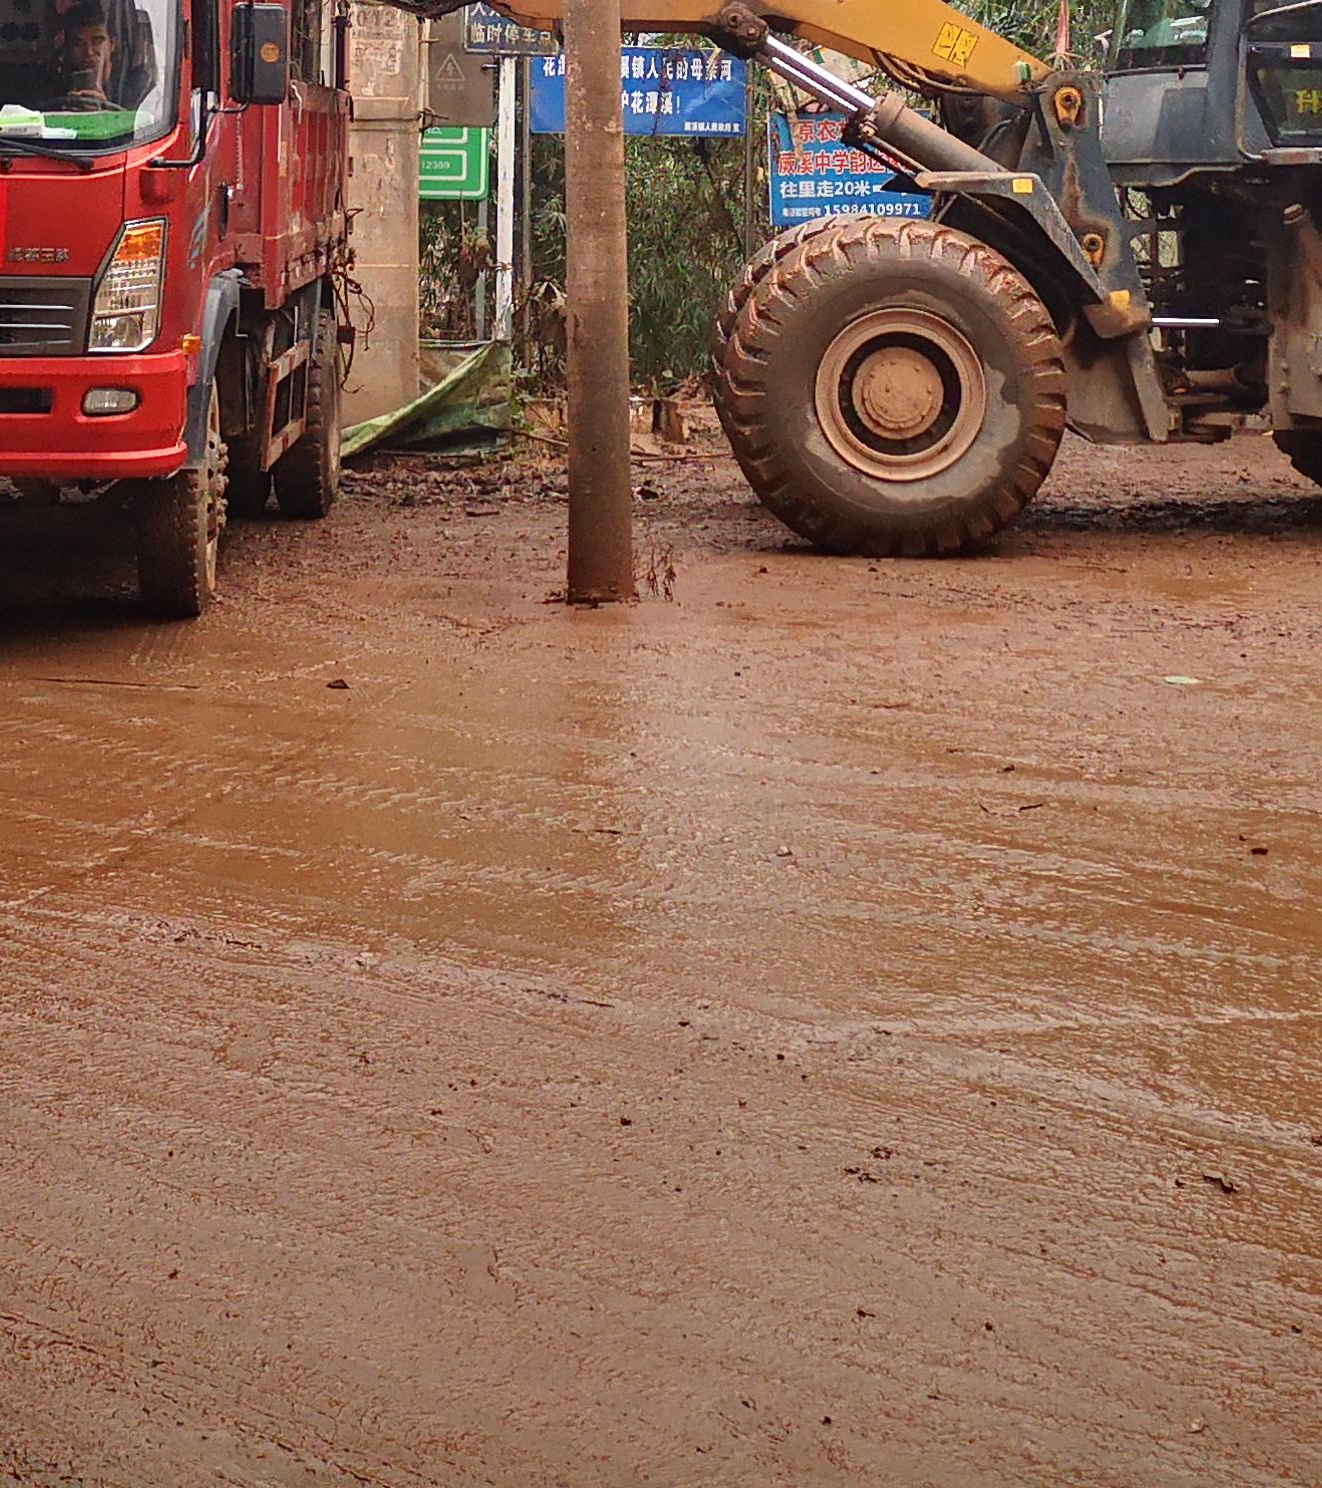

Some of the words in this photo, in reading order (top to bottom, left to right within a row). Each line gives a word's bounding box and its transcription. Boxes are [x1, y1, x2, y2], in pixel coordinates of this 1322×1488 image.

[780, 181, 871, 199] 往里走20米
[824, 202, 921, 218] 15984109971
